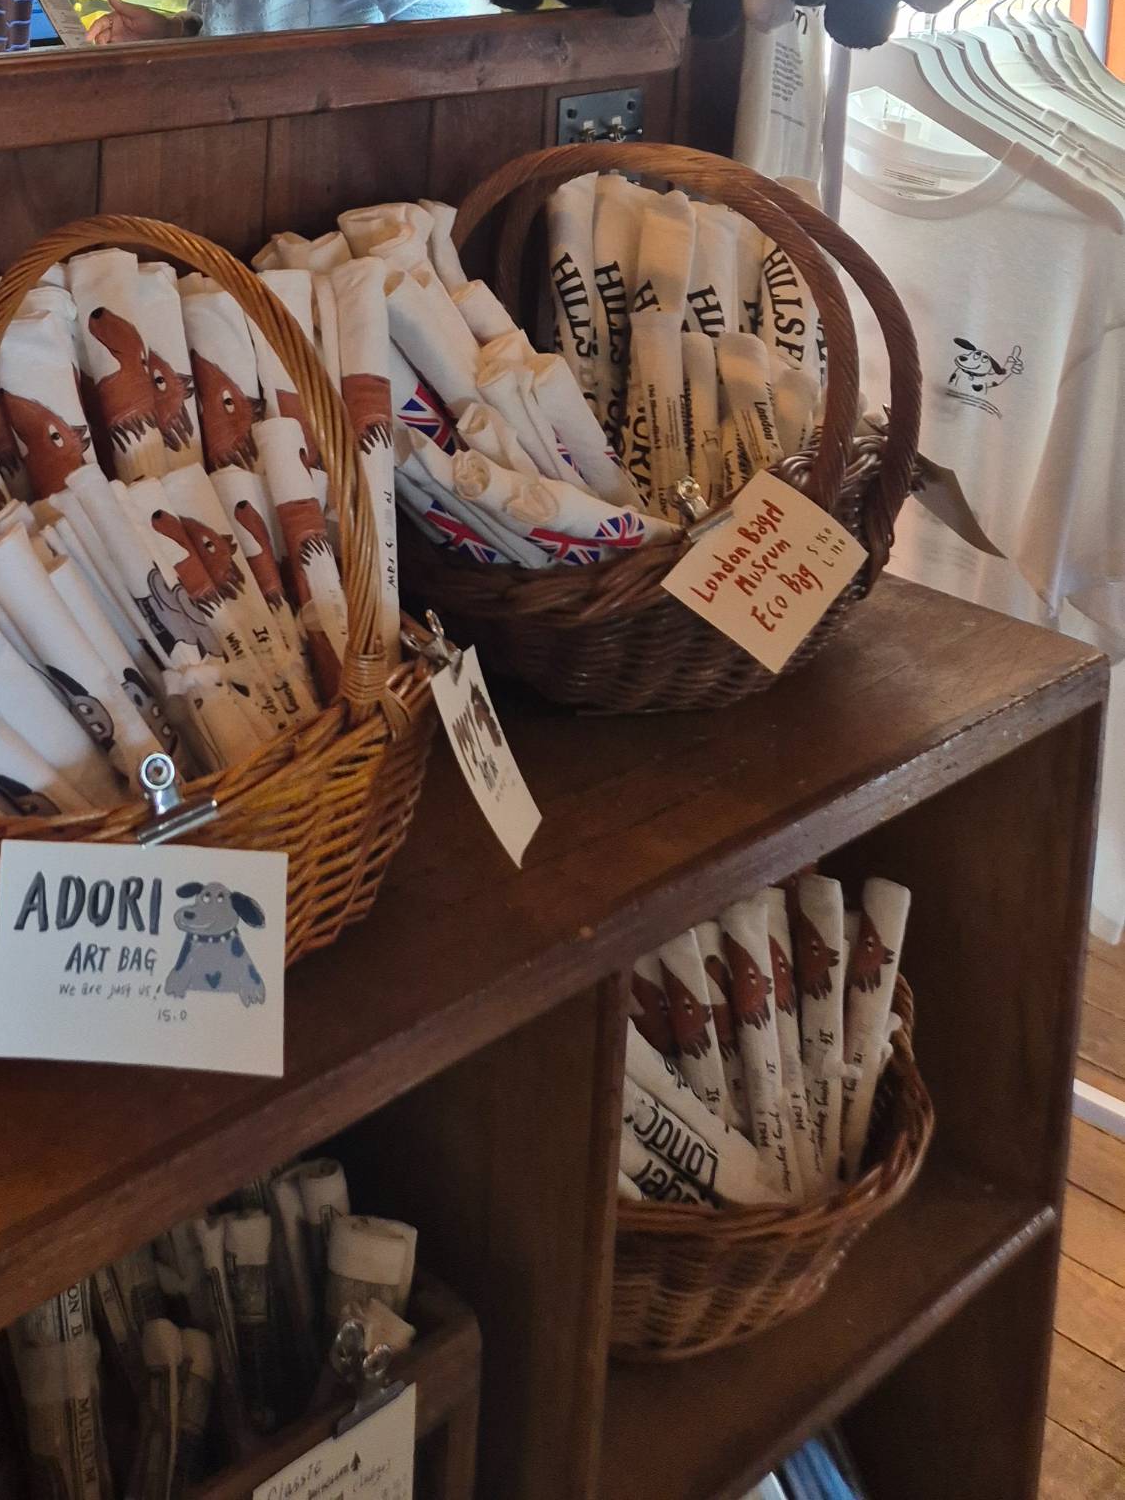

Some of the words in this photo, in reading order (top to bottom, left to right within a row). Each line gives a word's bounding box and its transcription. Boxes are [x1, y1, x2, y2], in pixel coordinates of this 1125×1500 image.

[690, 546, 751, 604] London
[777, 563, 824, 596] Bag
[14, 870, 163, 936] ADORI
[64, 941, 111, 975] ART
[116, 945, 158, 977] BAG
[58, 982, 76, 997] We
[81, 982, 103, 996] are
[157, 1008, 188, 1023] 15.0
